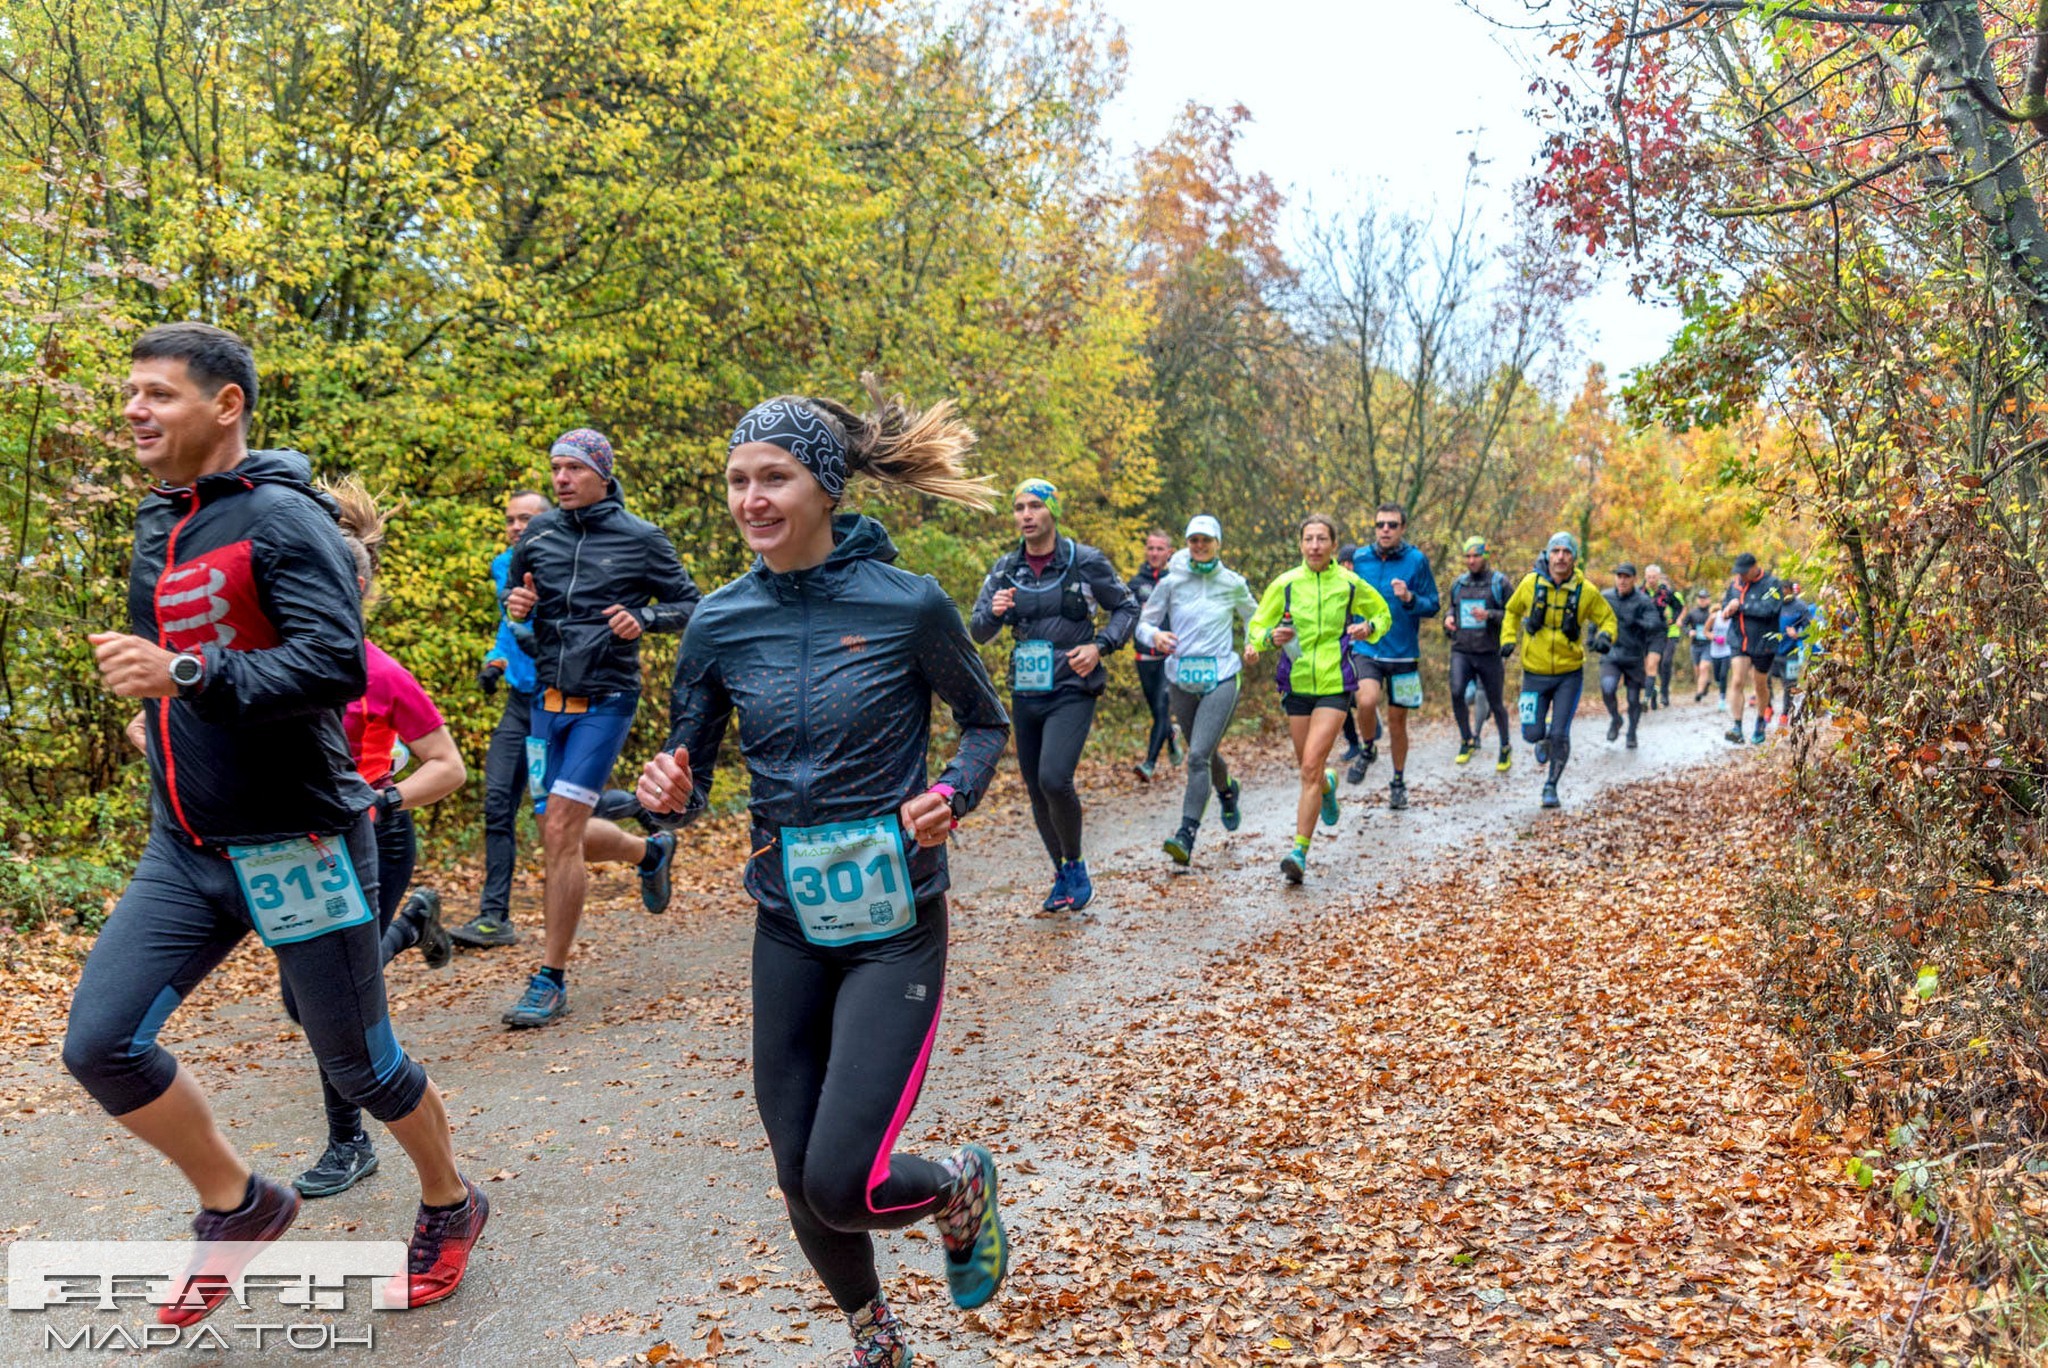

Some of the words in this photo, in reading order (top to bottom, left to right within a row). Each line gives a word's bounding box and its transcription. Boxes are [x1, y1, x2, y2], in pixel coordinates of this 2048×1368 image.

[1016, 655, 1049, 673] 330
[1179, 669, 1215, 684] 303
[250, 853, 351, 910] 313
[792, 853, 897, 906] 301
